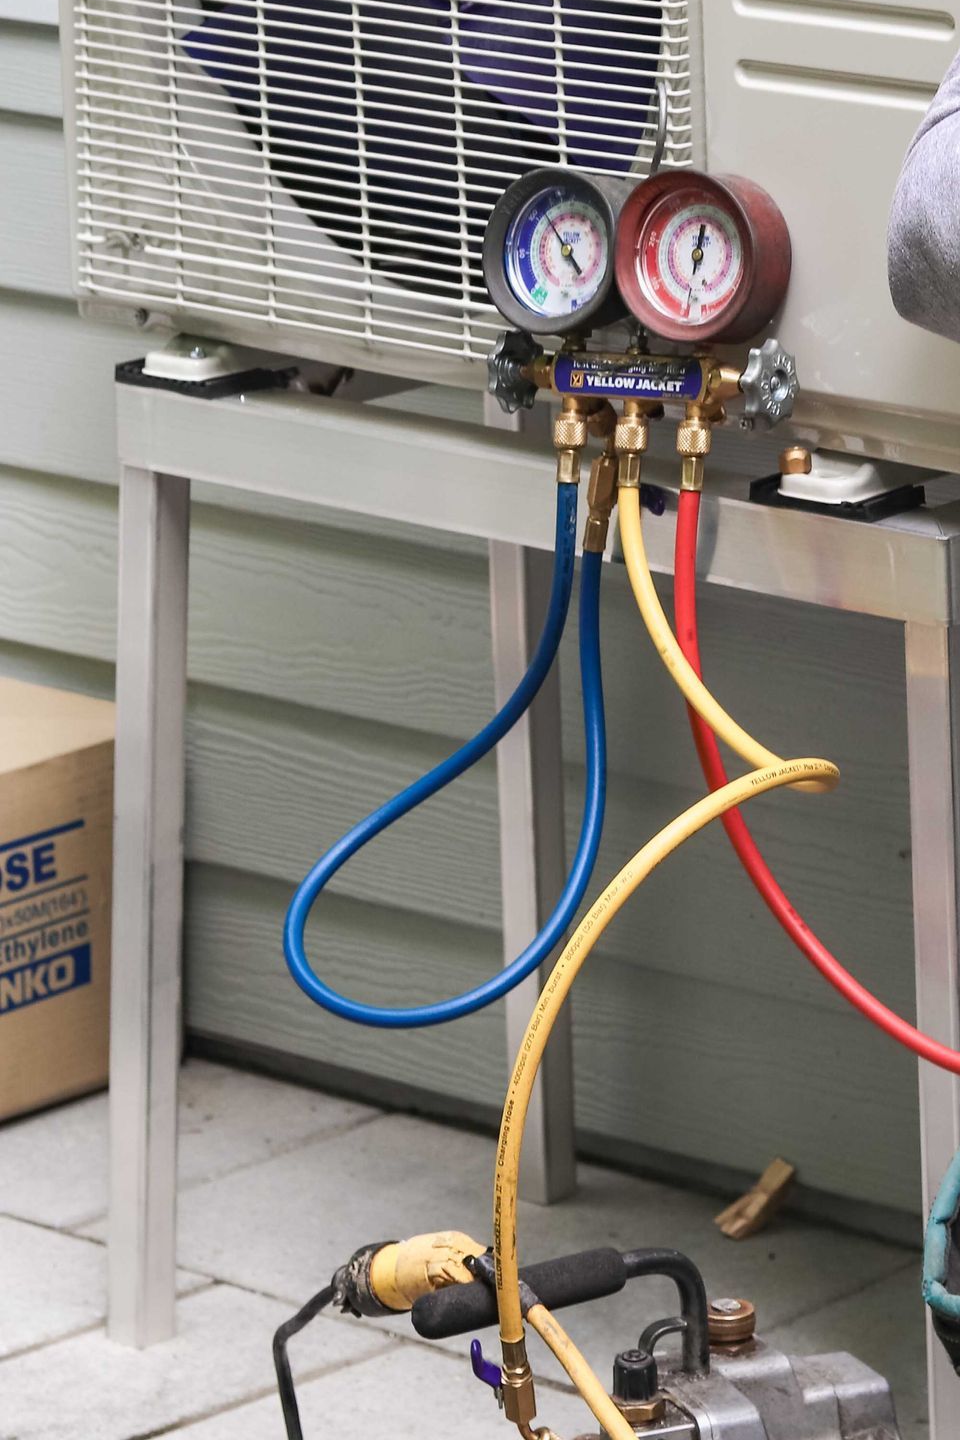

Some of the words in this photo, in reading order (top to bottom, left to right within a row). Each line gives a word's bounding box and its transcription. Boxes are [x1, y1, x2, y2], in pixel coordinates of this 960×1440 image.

[586, 374, 636, 390] YELLOW
[635, 378, 682, 392] JACKET
[0, 842, 57, 893] SE
[0, 919, 88, 962] thylene
[498, 1125, 510, 1167] Charging
[505, 1100, 515, 1123] Hose
